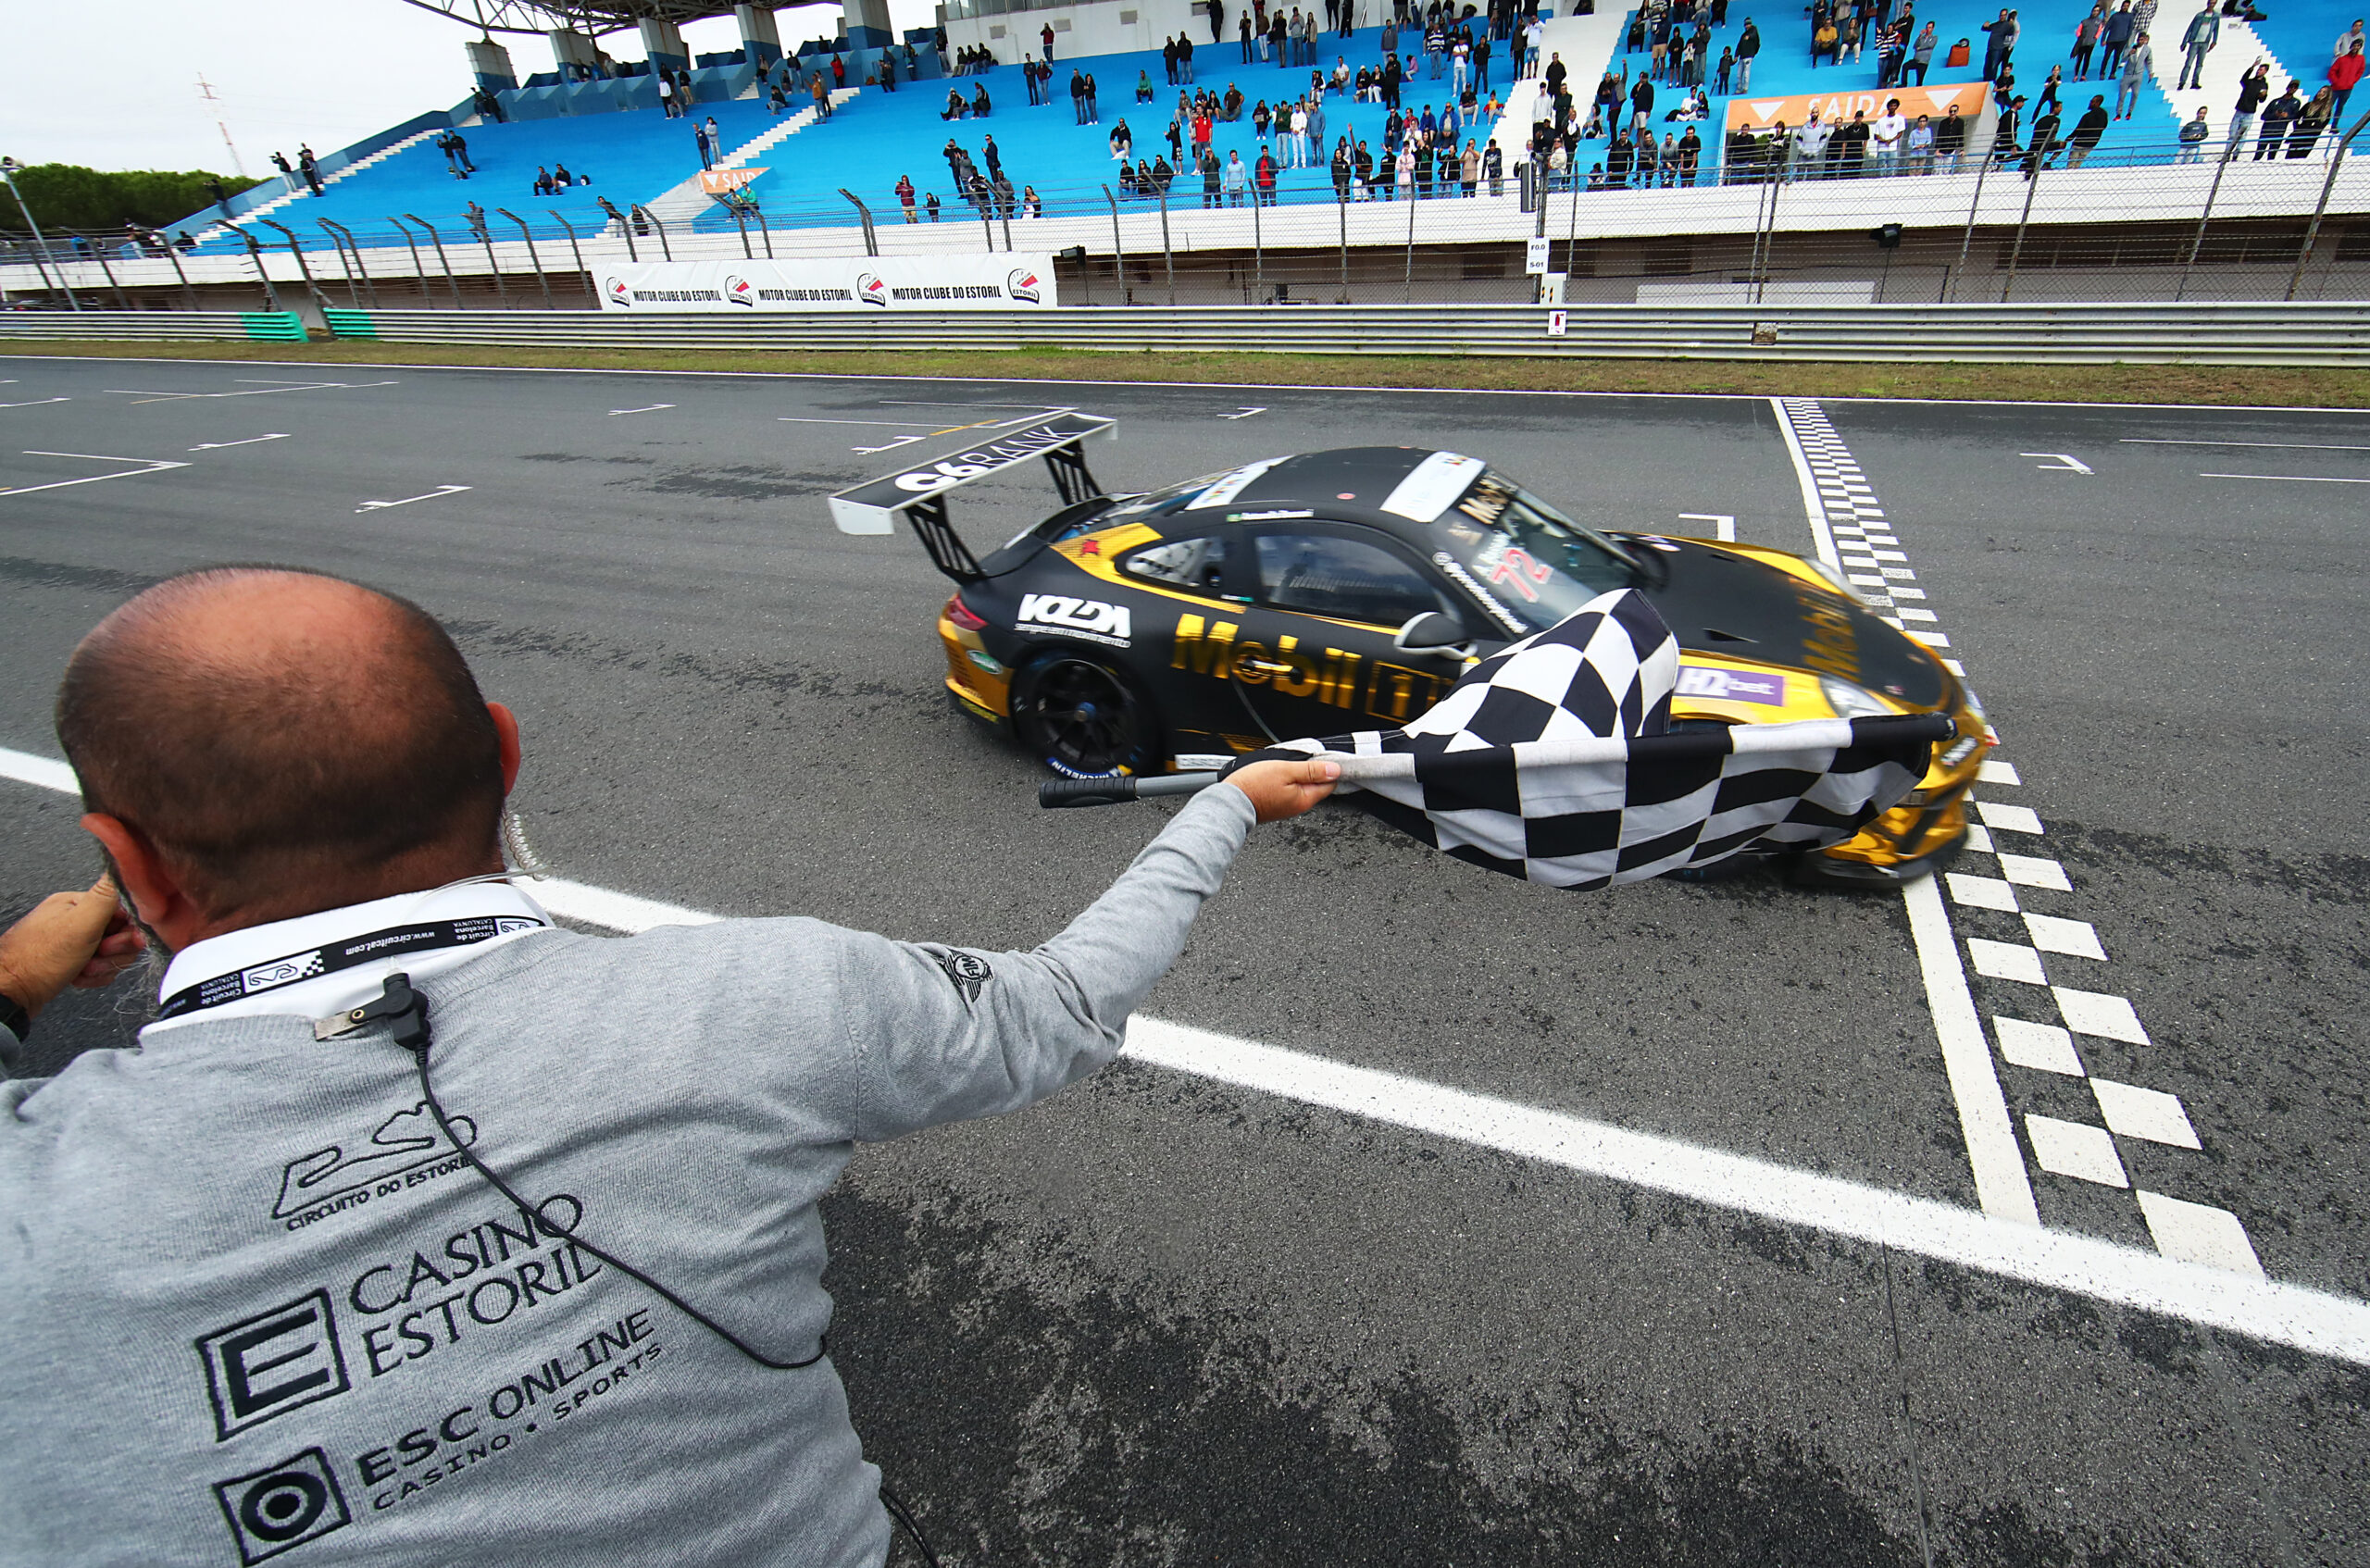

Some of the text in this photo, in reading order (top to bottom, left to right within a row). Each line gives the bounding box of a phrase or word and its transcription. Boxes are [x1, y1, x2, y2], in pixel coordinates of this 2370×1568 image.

[722, 171, 763, 188] SAID
[633, 290, 658, 302] MOTOR
[658, 290, 680, 302] CLUBE
[680, 290, 692, 302] DO
[692, 290, 722, 302] ESTORIL
[758, 289, 853, 301] MOTOR CLUBE DO ESTORIL
[892, 285, 1002, 301] MOTOR CLUBE DO ESTORIL
[1013, 289, 1037, 299] ESTORIL
[1487, 547, 1553, 603] 72
[1170, 614, 1362, 709] Mobil
[345, 931, 435, 955] www.circuitcat.com
[455, 925, 493, 934] Barcelona
[286, 1190, 370, 1231] CIRCUITO
[376, 1180, 402, 1198] DO
[349, 1193, 583, 1314] CASINO
[362, 1242, 603, 1378] ESTORIL
[356, 1308, 655, 1487] ESC ONLINE
[373, 1342, 663, 1511] CASINO SPORTS
